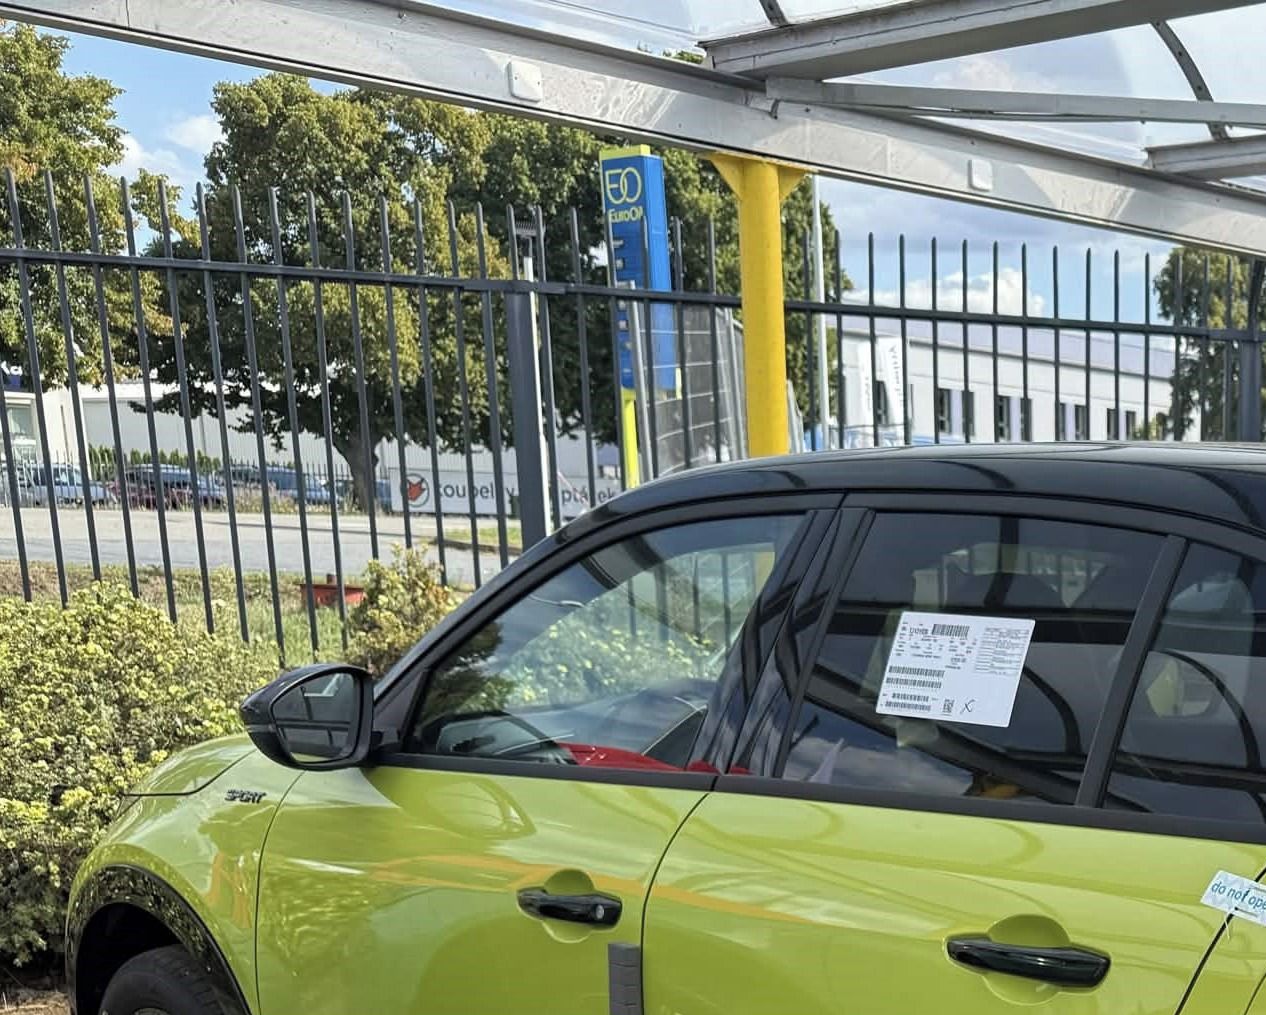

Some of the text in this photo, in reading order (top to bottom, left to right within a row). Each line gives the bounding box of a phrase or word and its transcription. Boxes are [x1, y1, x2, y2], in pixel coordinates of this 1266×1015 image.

[435, 481, 616, 505] oupely ptáek
[1211, 881, 1227, 895] do
[1227, 887, 1251, 903] not
